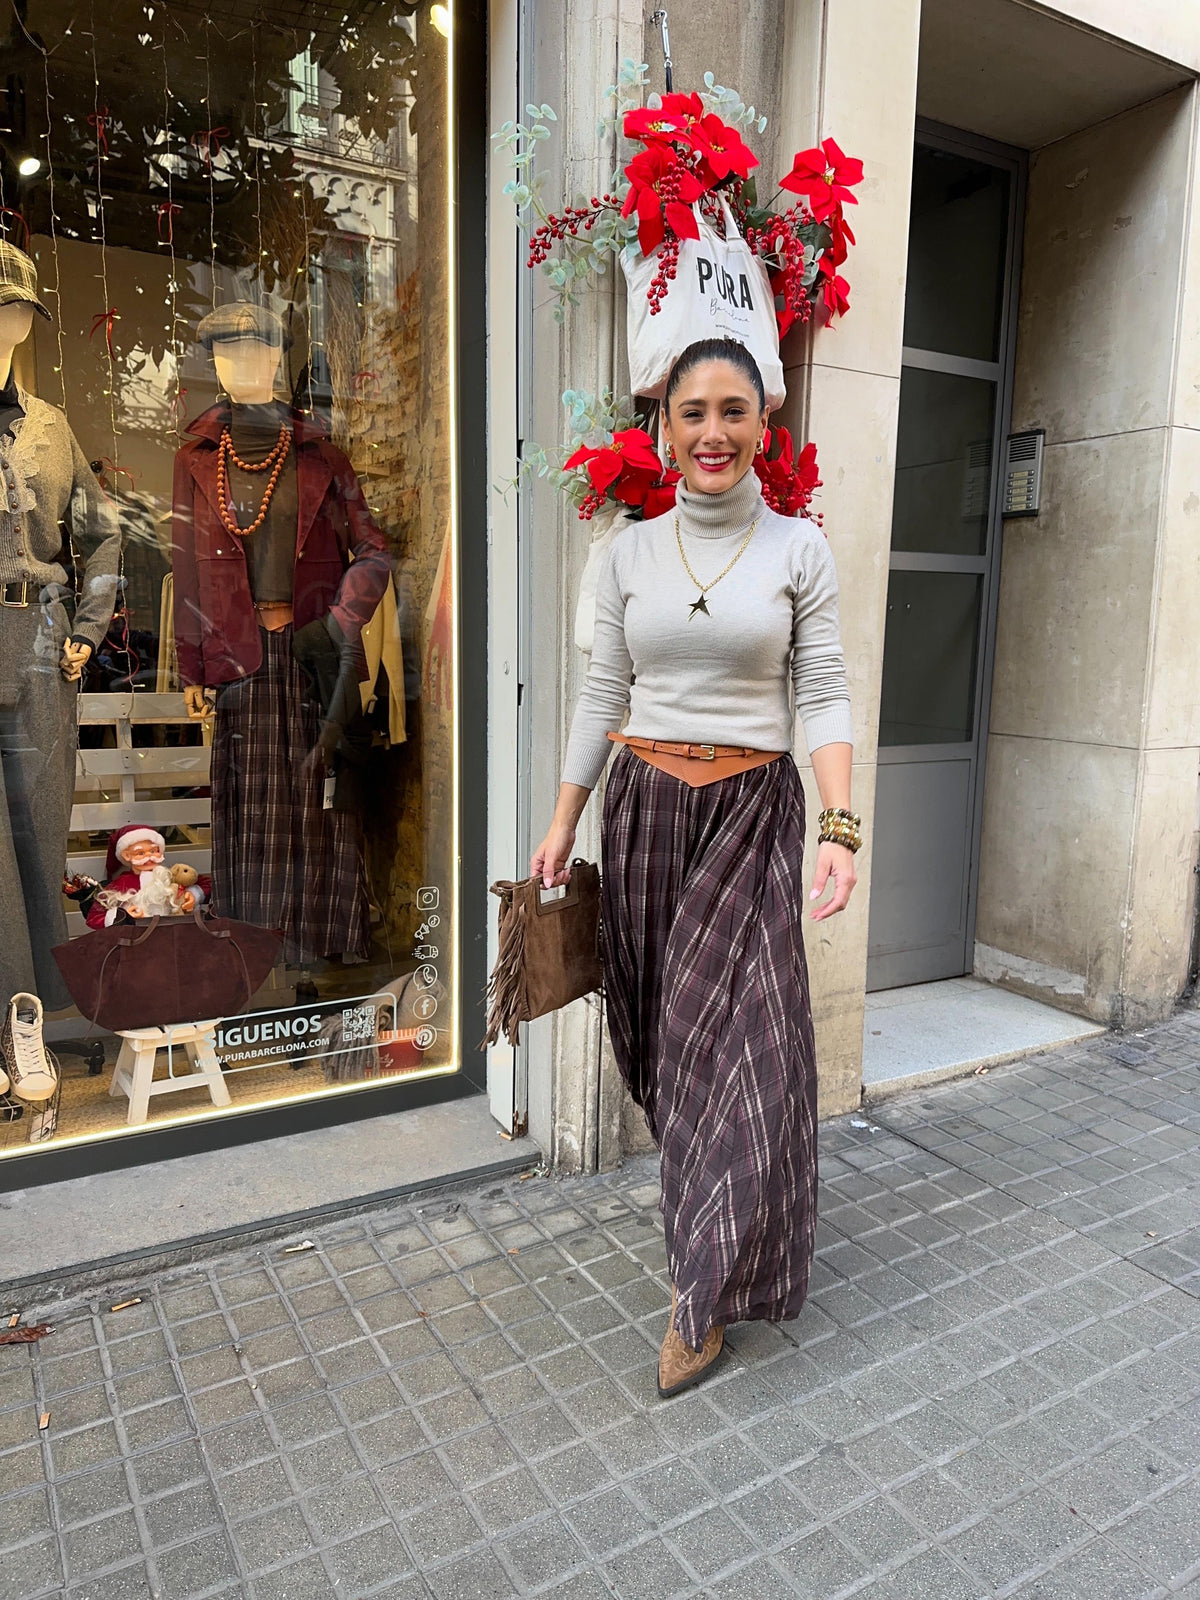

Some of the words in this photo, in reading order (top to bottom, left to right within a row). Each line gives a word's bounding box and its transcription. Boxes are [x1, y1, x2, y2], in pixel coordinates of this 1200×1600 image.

[697, 257, 754, 311] PURA
[710, 298, 750, 322] Balona
[203, 1014, 322, 1050] SIGUENOS
